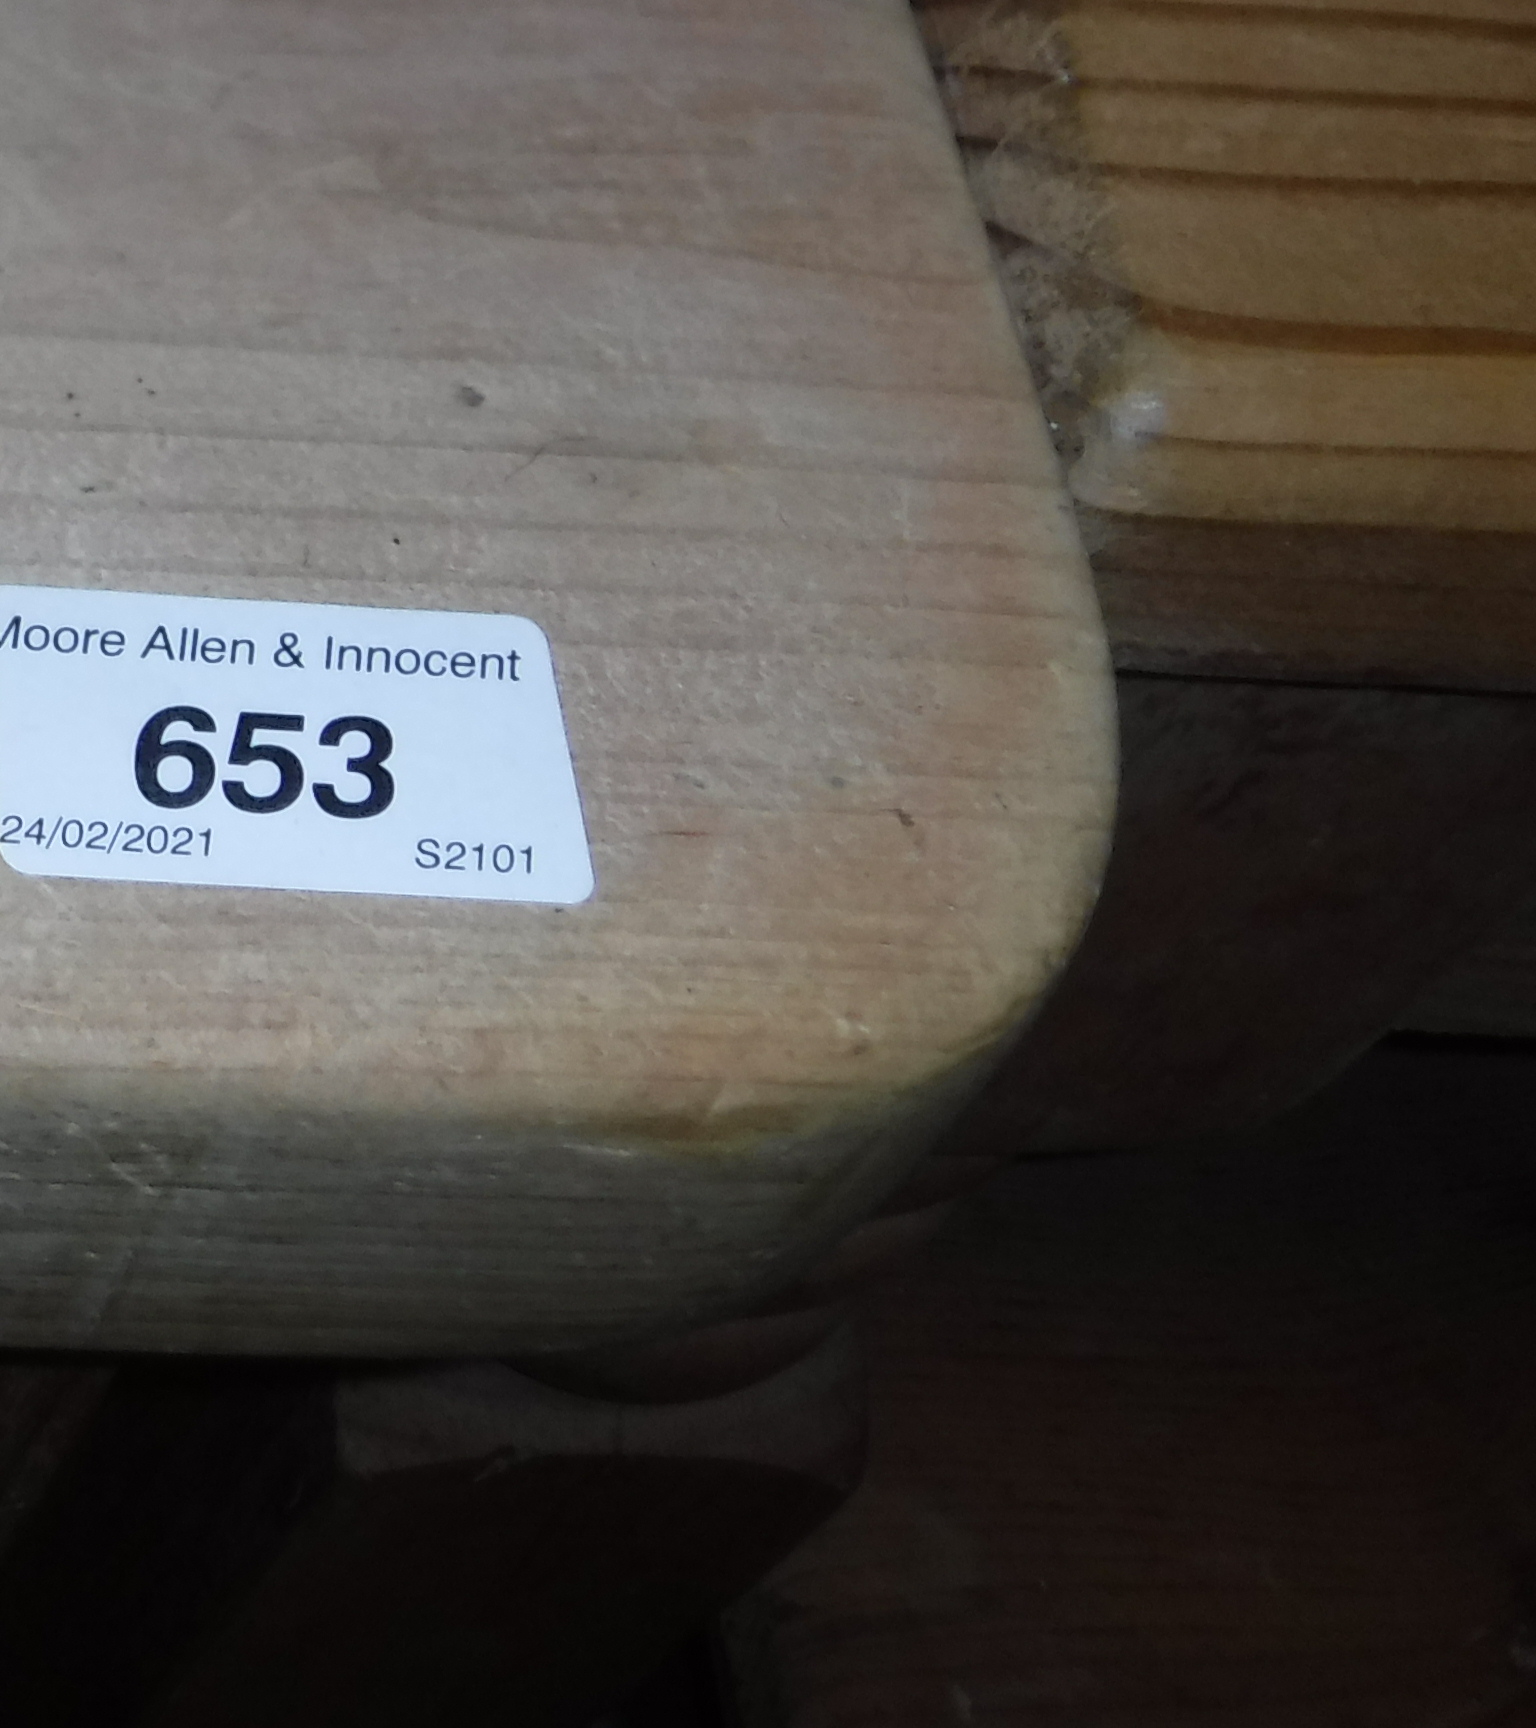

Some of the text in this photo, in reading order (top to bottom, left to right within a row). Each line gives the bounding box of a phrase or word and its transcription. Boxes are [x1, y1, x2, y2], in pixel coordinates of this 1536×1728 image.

[141, 625, 256, 666] Allen
[273, 632, 305, 669] &
[325, 635, 521, 682] Innocent
[133, 705, 396, 820] 653
[0, 815, 213, 858] 24/02/2021
[414, 838, 534, 875] S2101
